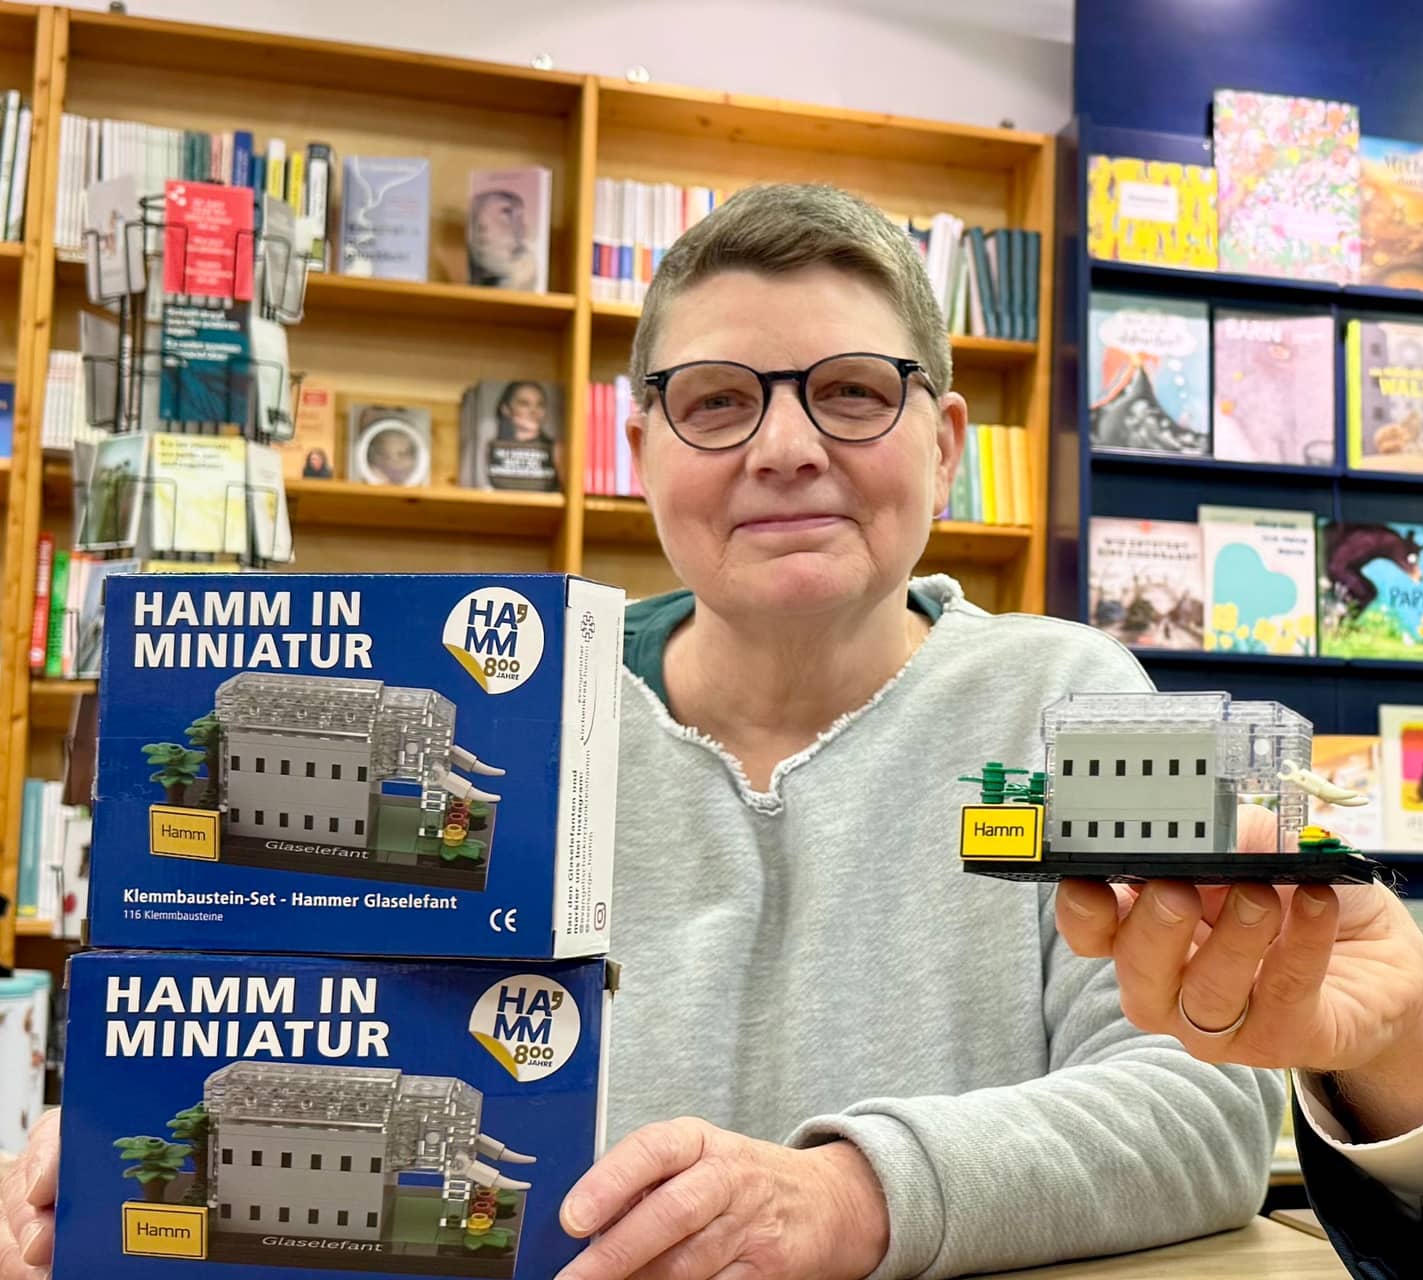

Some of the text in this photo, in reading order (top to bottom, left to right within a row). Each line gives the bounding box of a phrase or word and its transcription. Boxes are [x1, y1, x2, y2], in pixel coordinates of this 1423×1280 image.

[133, 591, 361, 627] HAMM IN
[133, 633, 374, 669] MINIATUR
[483, 657, 520, 678] 800
[496, 673, 520, 681] JAHRE
[161, 823, 206, 841] Hamm
[974, 821, 1025, 837] Hamm
[265, 840, 369, 860] Glaselefant
[123, 888, 276, 906] Klemmbaustein-Set
[291, 892, 359, 908] Hammer
[364, 893, 457, 910] Glaselefant
[123, 910, 224, 922] 116 Klemmbausteine
[106, 976, 378, 1014] HAMM IN
[104, 1020, 390, 1057] MINIATUR
[514, 1044, 554, 1065] 800
[527, 1059, 553, 1068] JAHRE
[136, 1221, 191, 1240] Hamm
[261, 1236, 384, 1252] Glaselefant
